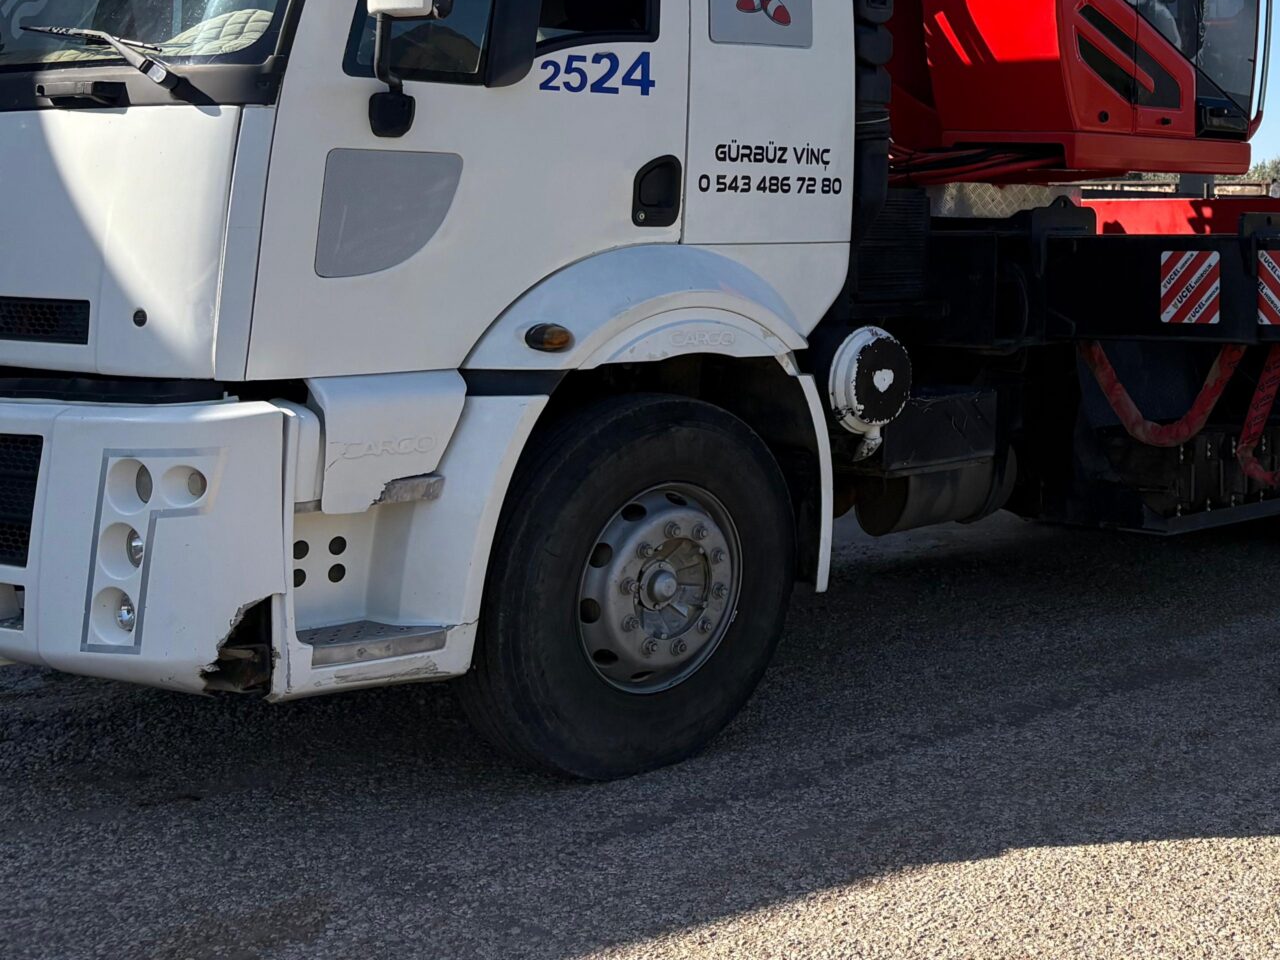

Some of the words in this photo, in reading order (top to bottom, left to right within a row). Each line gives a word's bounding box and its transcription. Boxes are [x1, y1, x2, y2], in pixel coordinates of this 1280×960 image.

[539, 51, 655, 96] 2524
[715, 139, 788, 164] GÜRBÜZ
[793, 142, 831, 172] VİNÇ
[698, 174, 711, 193] 0
[716, 174, 752, 193] 543
[756, 175, 791, 194] 486
[796, 177, 817, 194] 72
[821, 177, 843, 195] 80
[343, 435, 436, 459] CARGO
